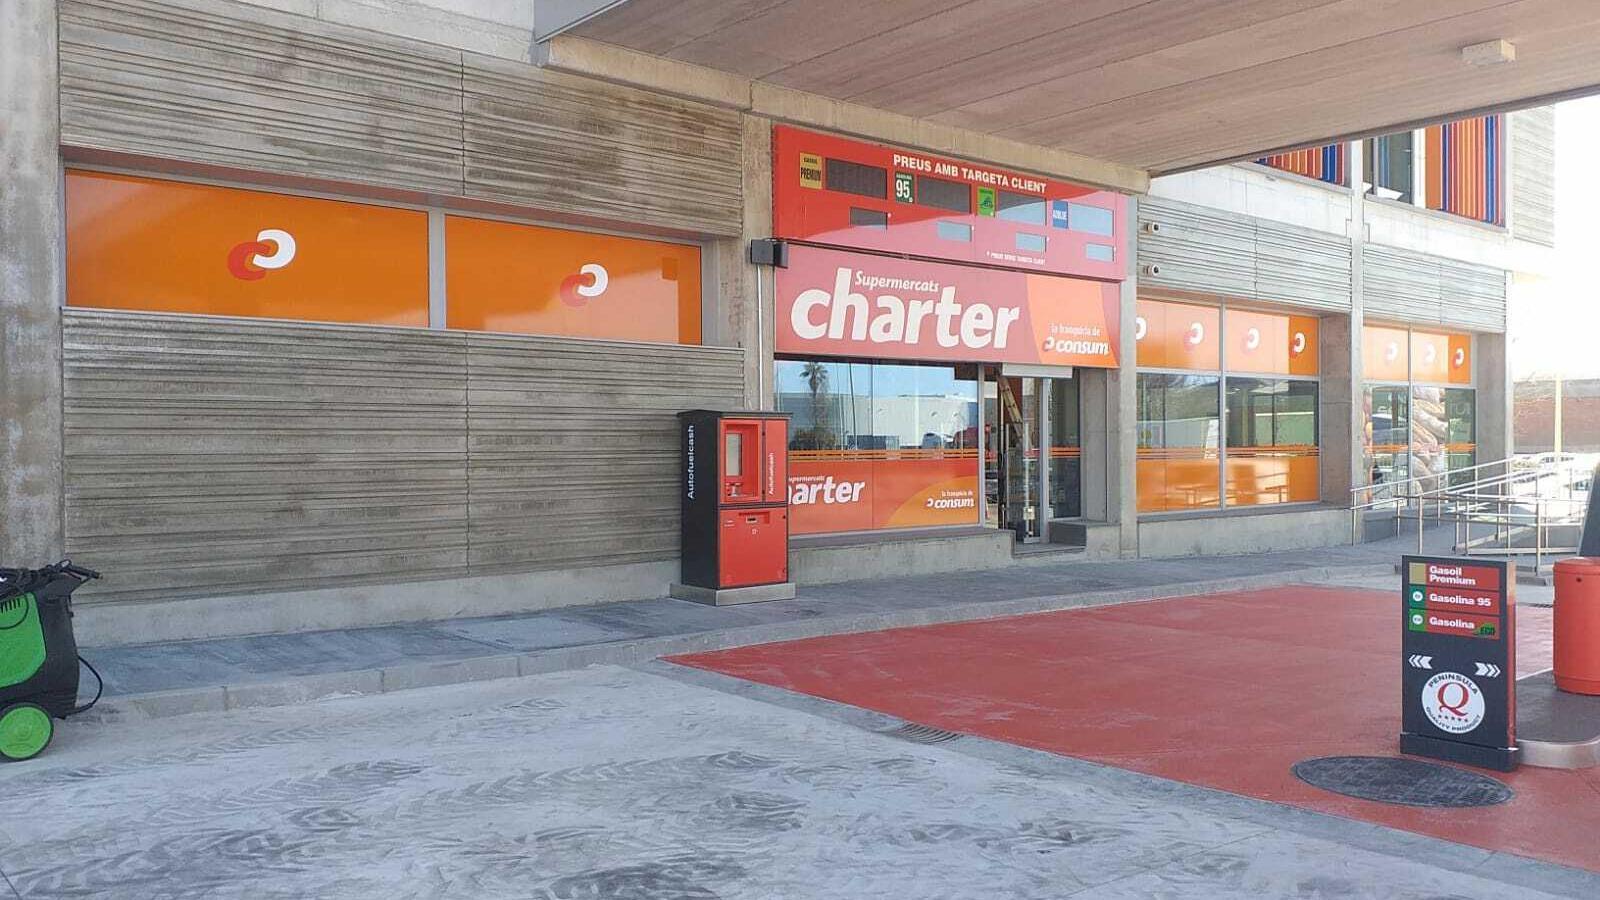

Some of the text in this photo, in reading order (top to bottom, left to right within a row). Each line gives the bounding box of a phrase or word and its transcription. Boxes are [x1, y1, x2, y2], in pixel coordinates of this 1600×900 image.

[894, 154, 1047, 194] PREUS AMB TARGETA CLIENT
[896, 179, 910, 198] 95
[855, 270, 939, 292] Supermercats
[790, 267, 1020, 349] charter
[1055, 339, 1109, 356] consum
[687, 425, 695, 499] Autofuelcash
[935, 498, 975, 508] consum
[1429, 566, 1462, 576] Gasoil
[1429, 574, 1476, 585] Premium
[1429, 593, 1475, 605] Gasolina
[1476, 597, 1492, 607] 95
[1429, 617, 1475, 629] Gasolina
[1428, 673, 1478, 695] PENINSULA
[1437, 682, 1469, 717] Q
